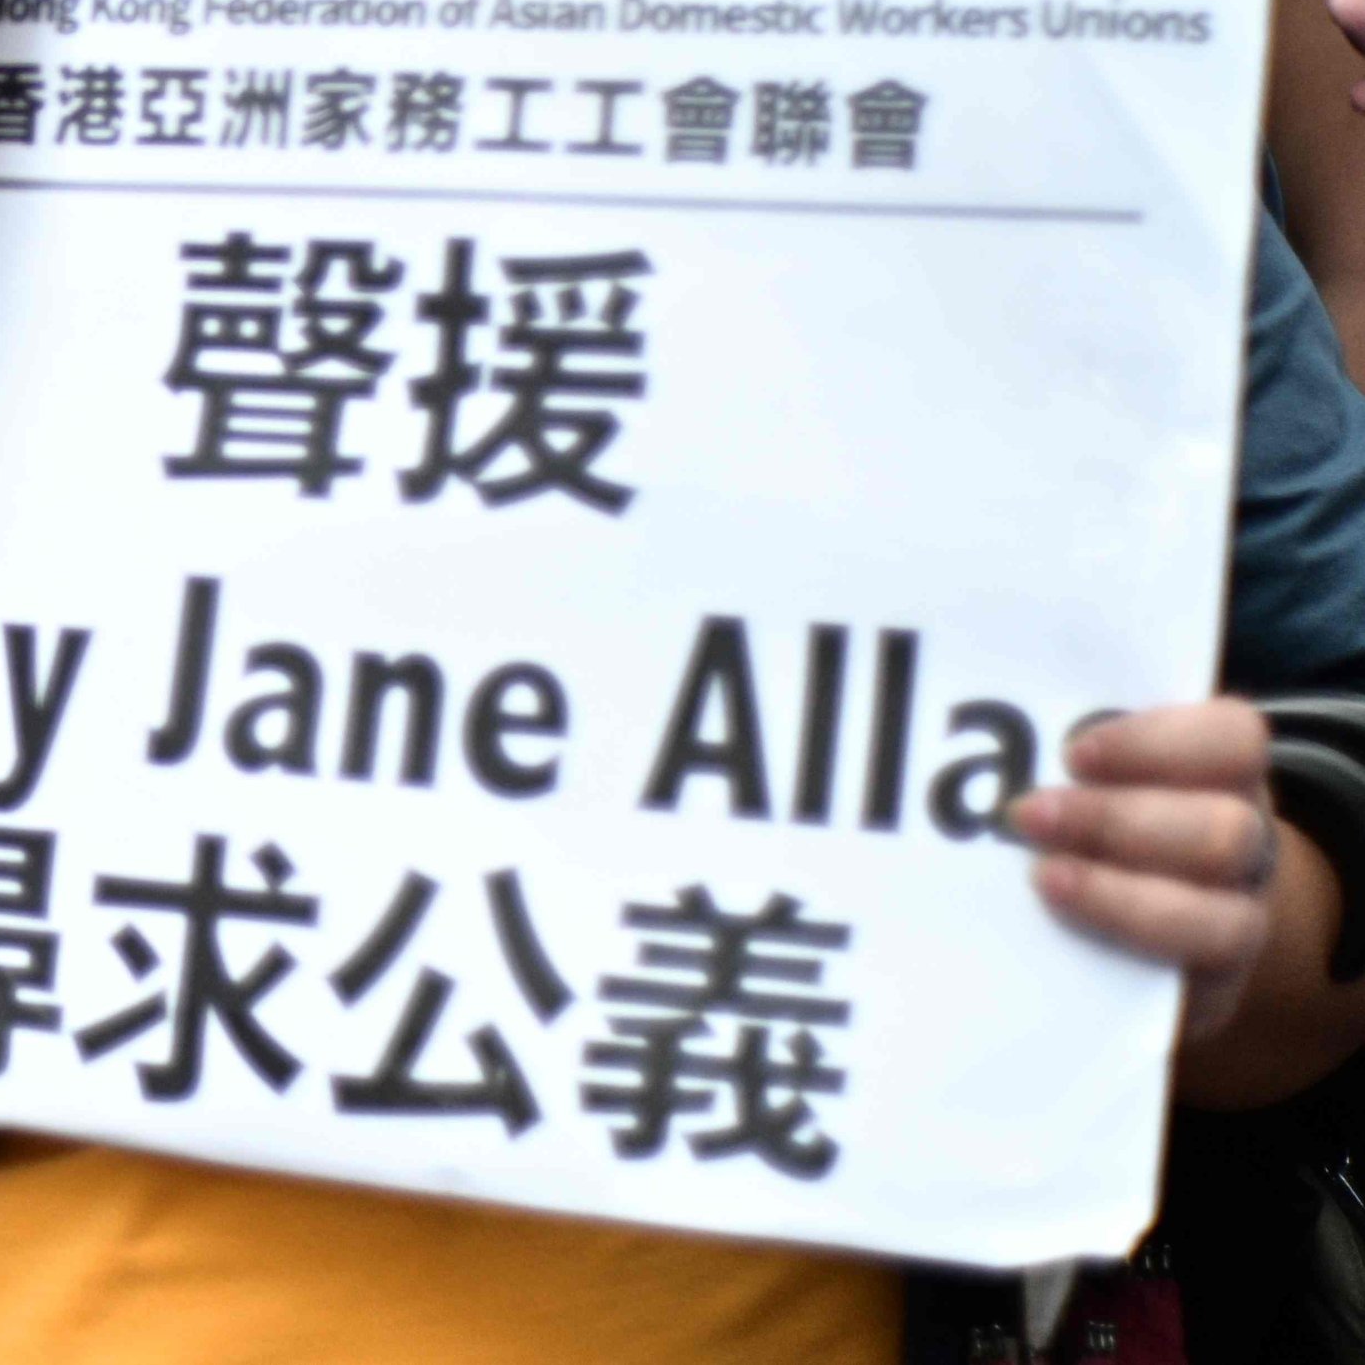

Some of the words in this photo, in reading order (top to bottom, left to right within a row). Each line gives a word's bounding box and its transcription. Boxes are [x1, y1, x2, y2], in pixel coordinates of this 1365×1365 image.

[1040, 0, 1212, 44] Unions
[160, 230, 655, 517] 聲援
[144, 572, 571, 800] Jane
[638, 612, 1132, 845] Alla
